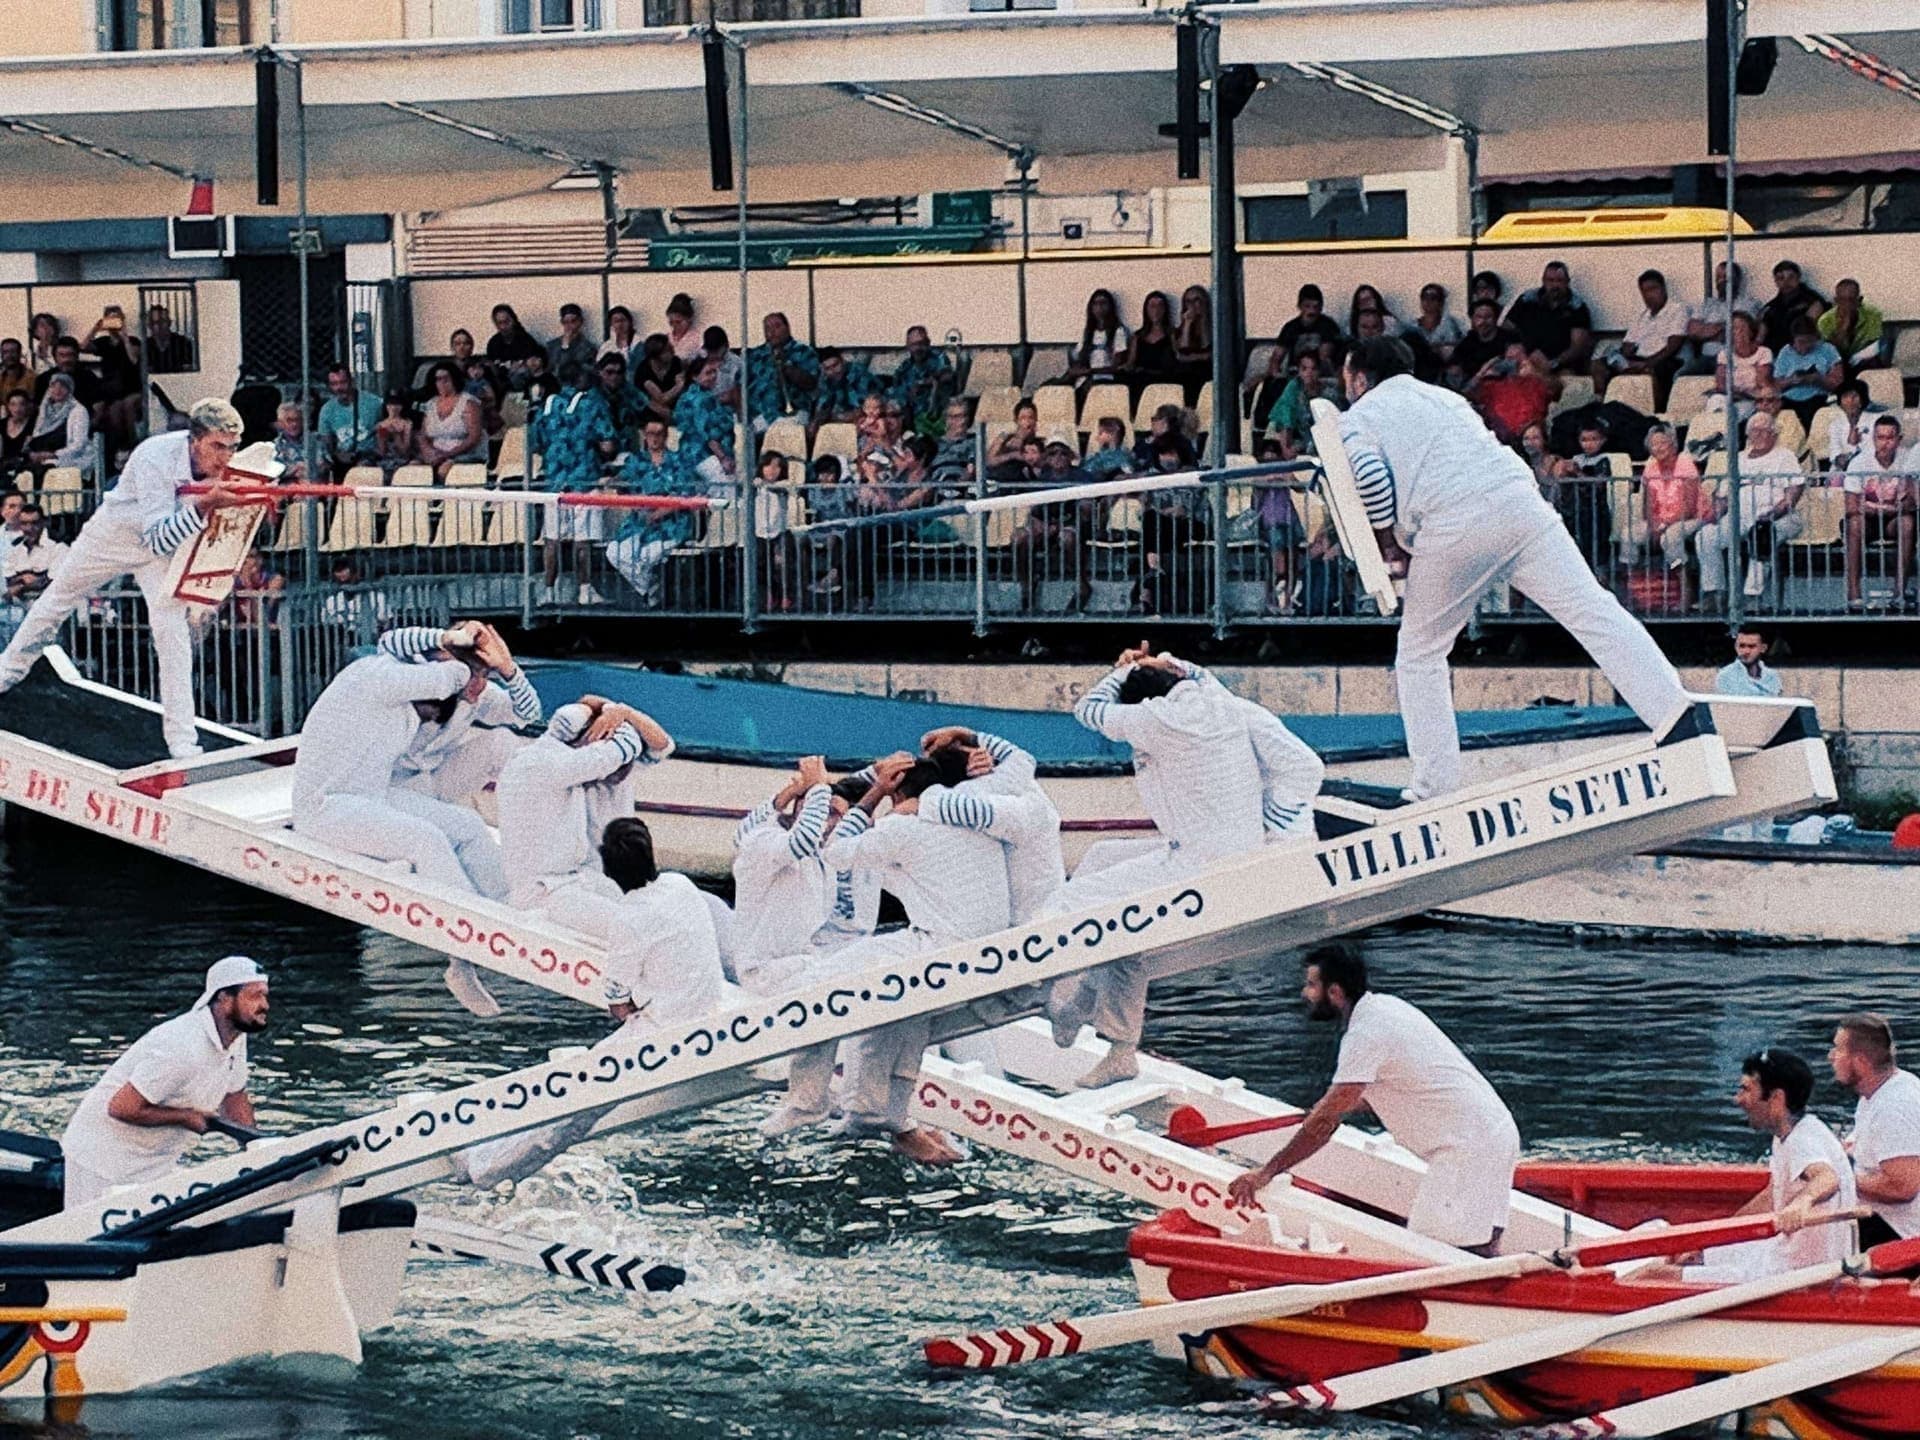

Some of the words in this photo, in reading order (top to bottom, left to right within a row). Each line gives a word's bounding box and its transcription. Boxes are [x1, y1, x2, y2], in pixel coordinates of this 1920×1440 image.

[25, 769, 70, 810] DE
[84, 790, 172, 845] SETE
[1315, 821, 1447, 887] VILLE
[1467, 798, 1528, 847] DE
[1548, 759, 1668, 824] SETE
